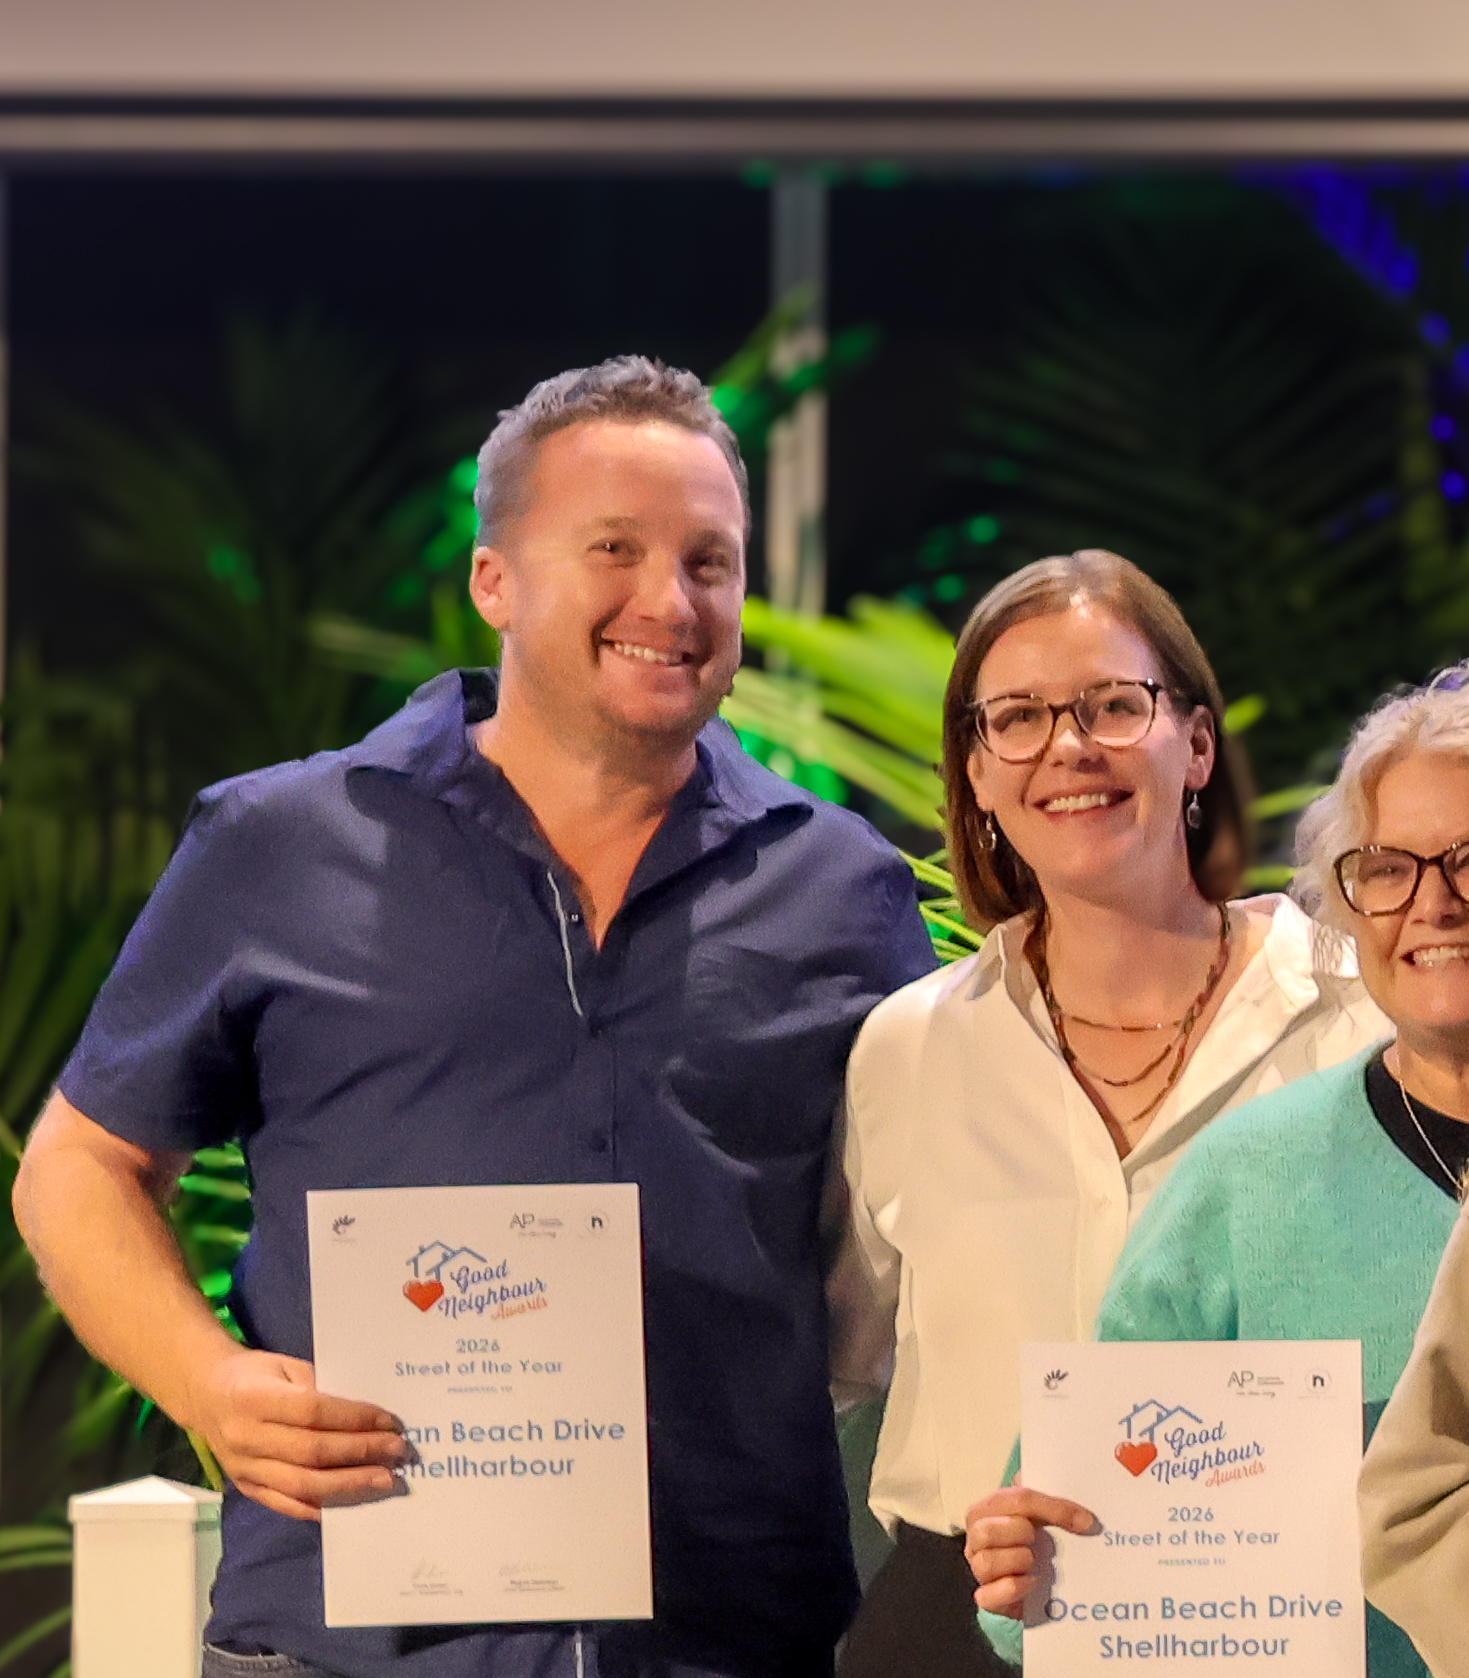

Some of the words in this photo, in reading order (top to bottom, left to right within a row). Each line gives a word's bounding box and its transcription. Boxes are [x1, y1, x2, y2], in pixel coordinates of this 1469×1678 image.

[450, 1259, 508, 1293] Good
[437, 1279, 547, 1319] Neighbour
[456, 1339, 500, 1353] 2026
[395, 1362, 450, 1376] Street
[458, 1361, 476, 1375] of
[482, 1361, 512, 1374] the
[519, 1360, 563, 1374] Year
[452, 1420, 542, 1442] Beach
[555, 1418, 625, 1440] Drive
[1164, 1422, 1226, 1451] Good
[1151, 1441, 1265, 1484] Neighbour
[1205, 1461, 1266, 1487] Awards
[1168, 1507, 1214, 1522] 2026
[1104, 1529, 1161, 1547] Street
[1168, 1529, 1188, 1545] of
[1194, 1529, 1226, 1545] the
[1234, 1528, 1280, 1545] Year
[1045, 1597, 1148, 1622] Ocean
[1162, 1595, 1257, 1620] Beach
[1269, 1594, 1343, 1618] Drive
[1100, 1635, 1289, 1659] Shellharbour
